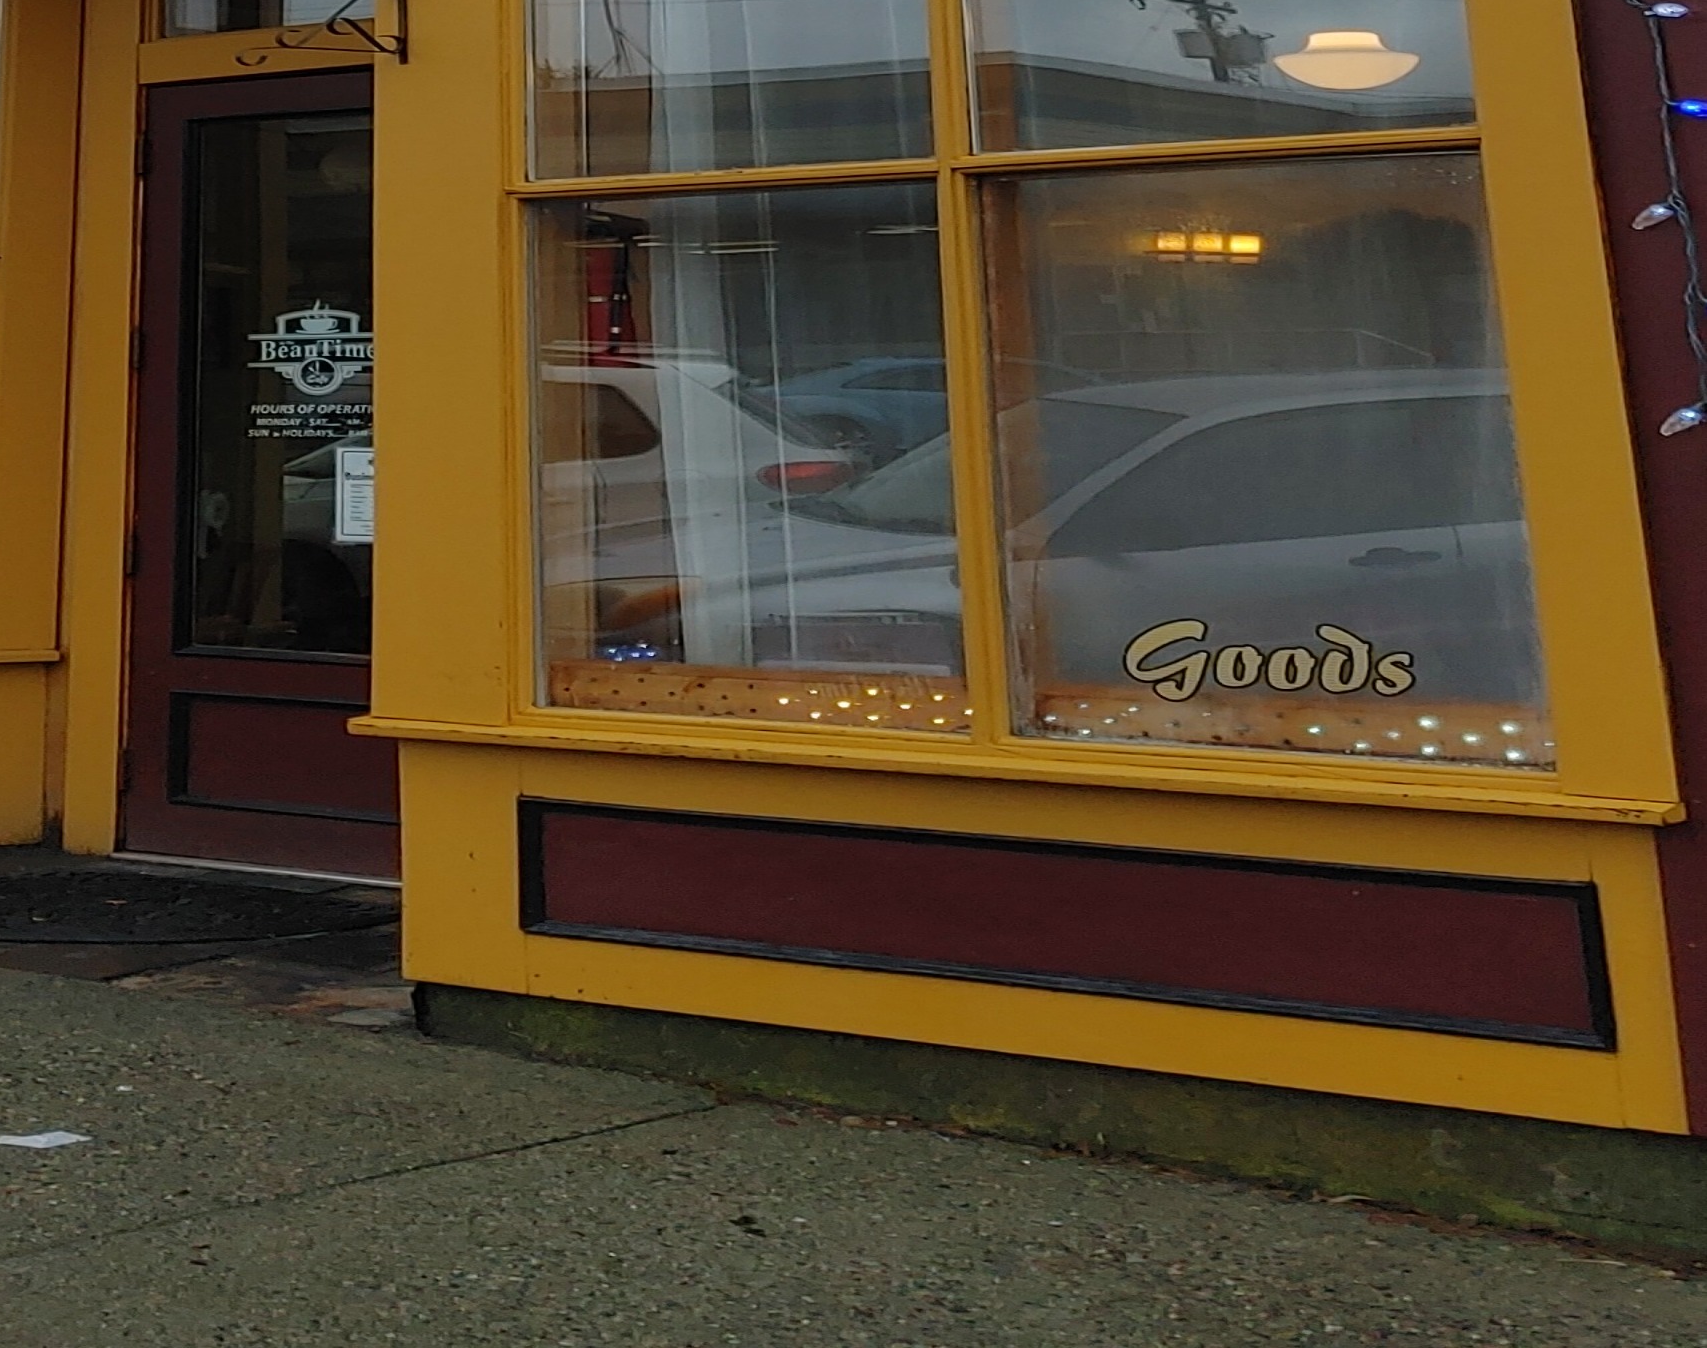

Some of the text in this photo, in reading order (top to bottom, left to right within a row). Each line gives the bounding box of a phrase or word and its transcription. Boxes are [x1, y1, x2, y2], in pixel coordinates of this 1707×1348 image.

[260, 339, 374, 361] BeanTime
[250, 404, 295, 414] HOURS
[297, 404, 315, 414] OF
[247, 429, 270, 437] SUN
[1123, 619, 1416, 702] Goods
